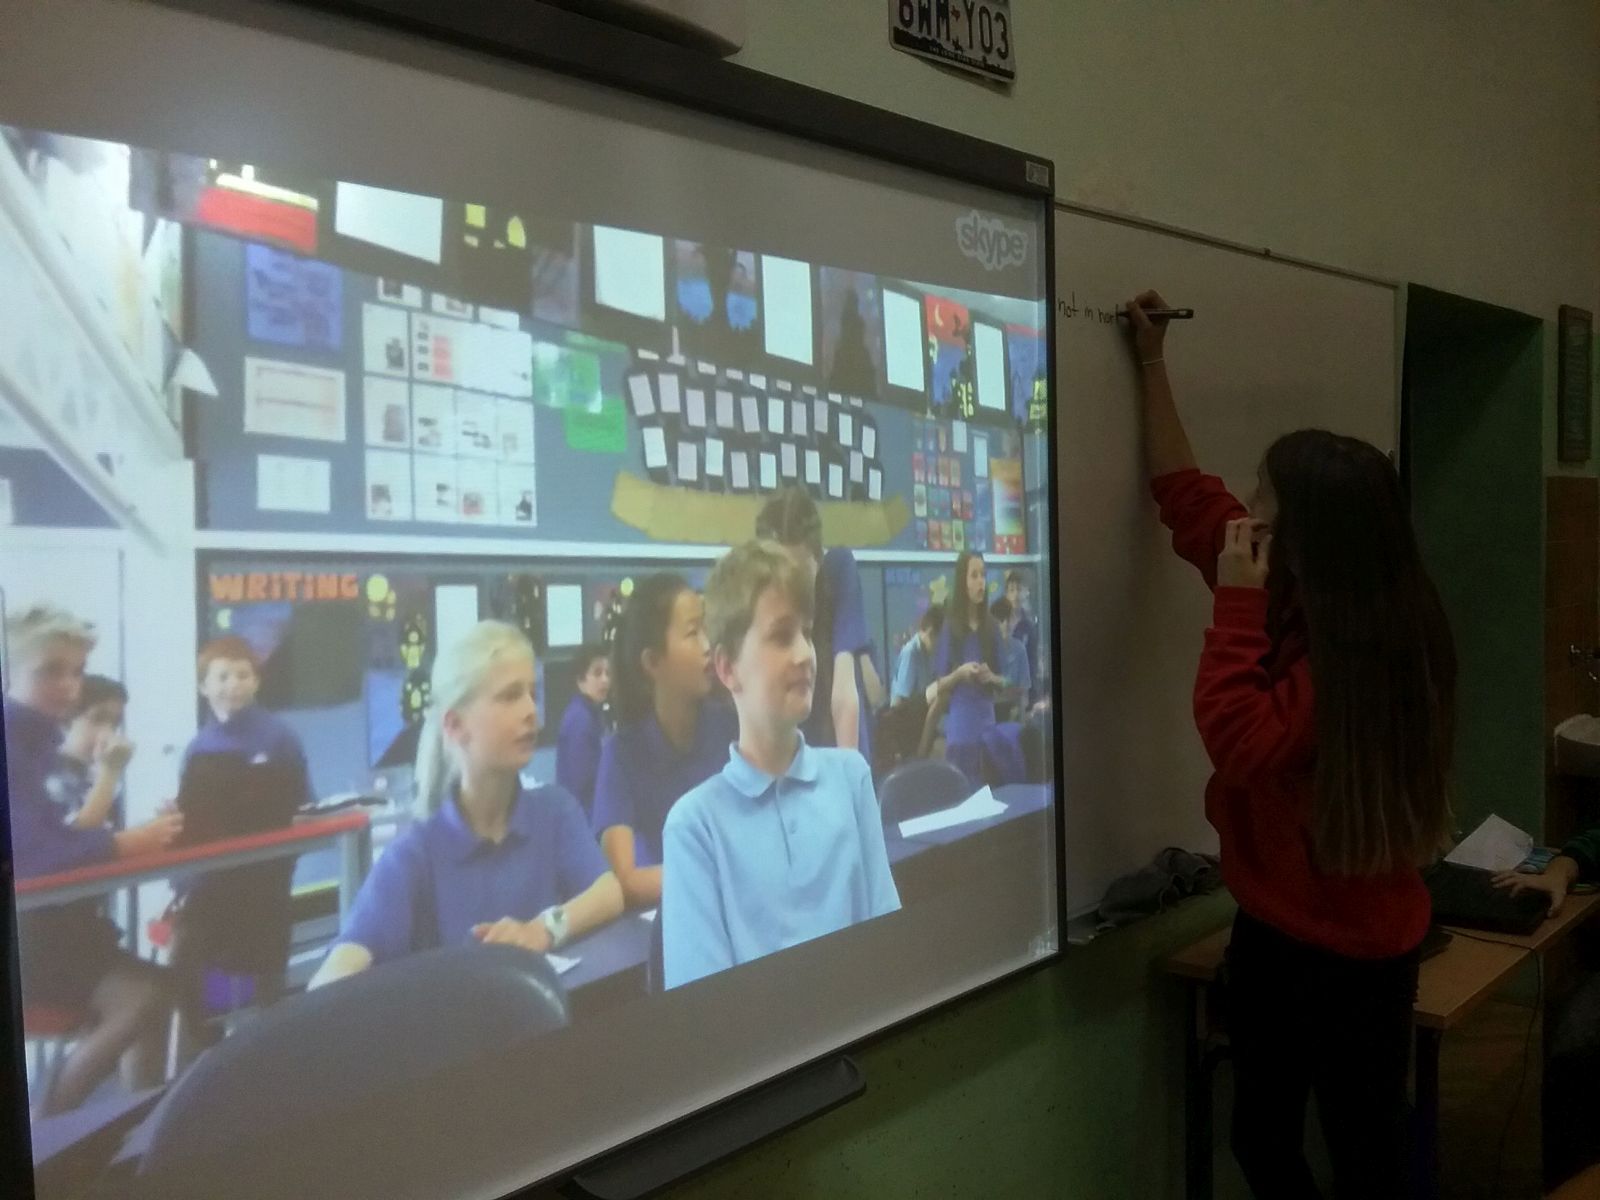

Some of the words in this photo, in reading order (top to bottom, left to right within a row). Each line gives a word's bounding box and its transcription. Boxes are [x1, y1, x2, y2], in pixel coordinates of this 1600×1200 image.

[961, 215, 1024, 264] skype
[1057, 291, 1079, 318] not
[209, 571, 359, 603] WRITING
